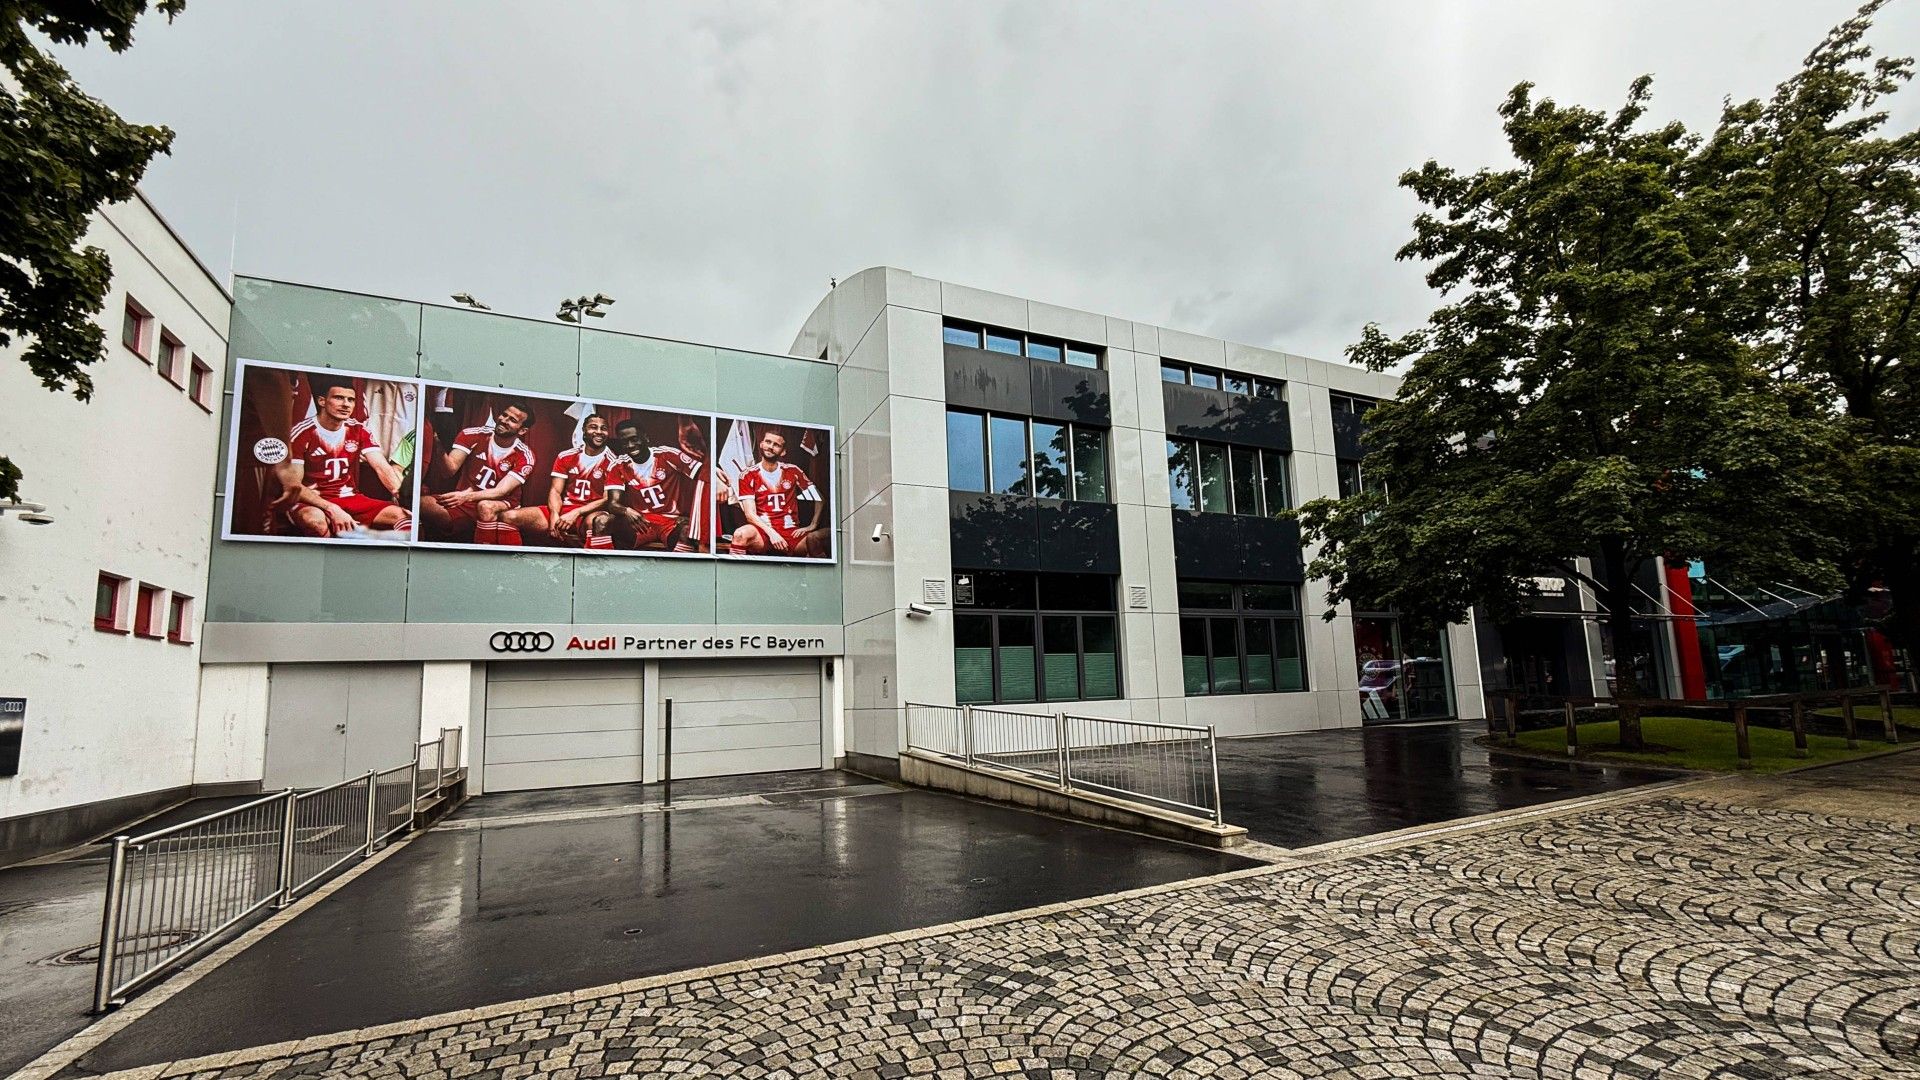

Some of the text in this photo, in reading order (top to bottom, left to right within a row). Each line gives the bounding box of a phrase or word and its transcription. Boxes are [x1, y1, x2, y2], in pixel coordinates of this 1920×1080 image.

[566, 636, 824, 652] Audi Partner des FC Bayern
